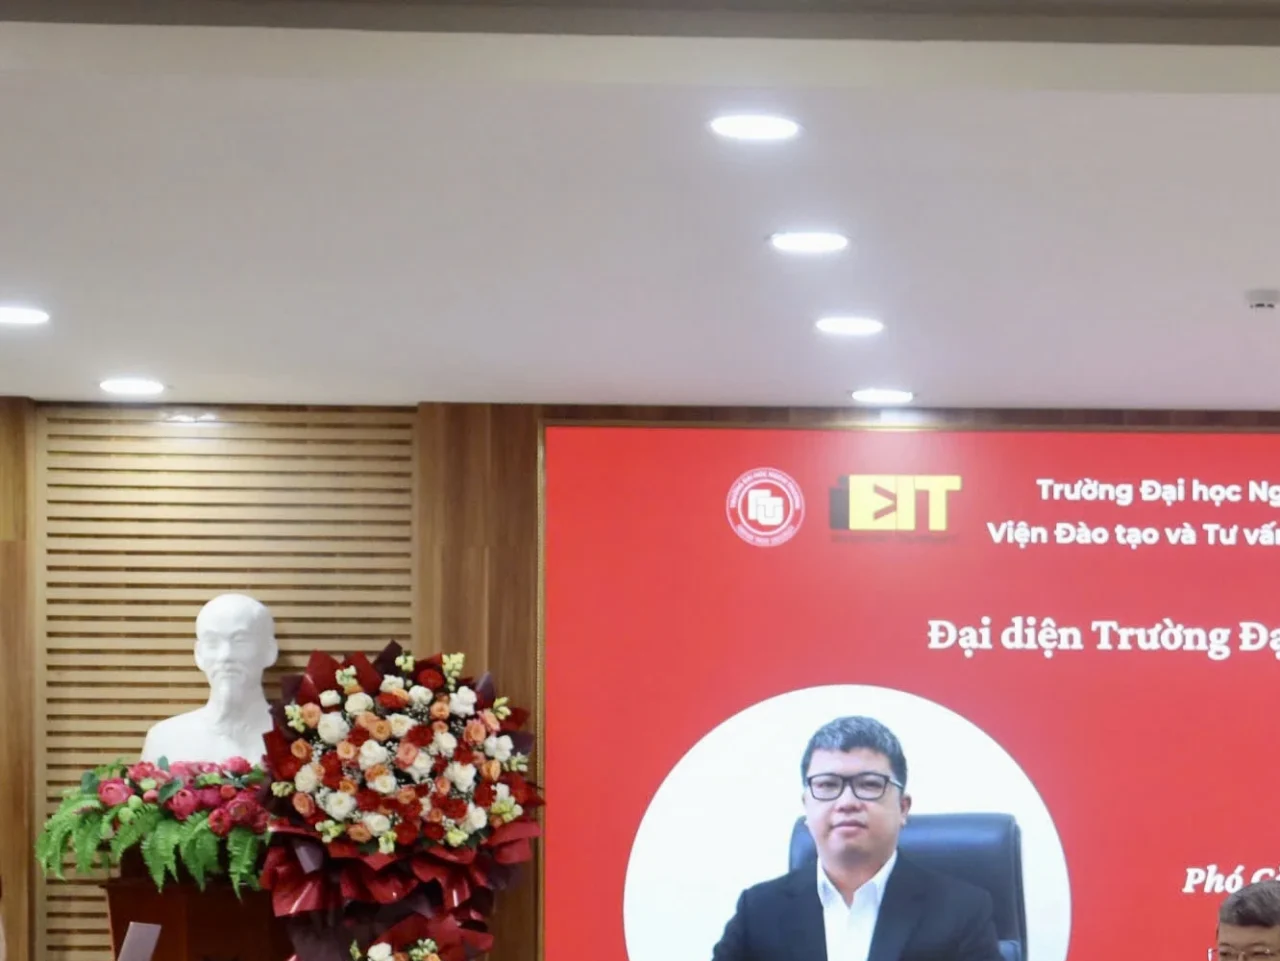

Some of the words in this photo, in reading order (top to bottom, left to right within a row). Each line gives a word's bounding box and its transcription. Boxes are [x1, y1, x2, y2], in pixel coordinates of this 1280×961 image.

[1035, 477, 1134, 507] Trường
[1139, 477, 1186, 507] Đại
[1191, 478, 1242, 507] học
[986, 519, 1049, 549] Viện
[1053, 521, 1110, 545] Đào
[1114, 523, 1160, 550] tạo
[1164, 522, 1197, 546] và
[1202, 523, 1239, 546] Tư
[926, 615, 993, 659] Đại
[1000, 615, 1085, 659] diện
[1090, 617, 1232, 661] Trường
[1181, 863, 1245, 895] Phó
